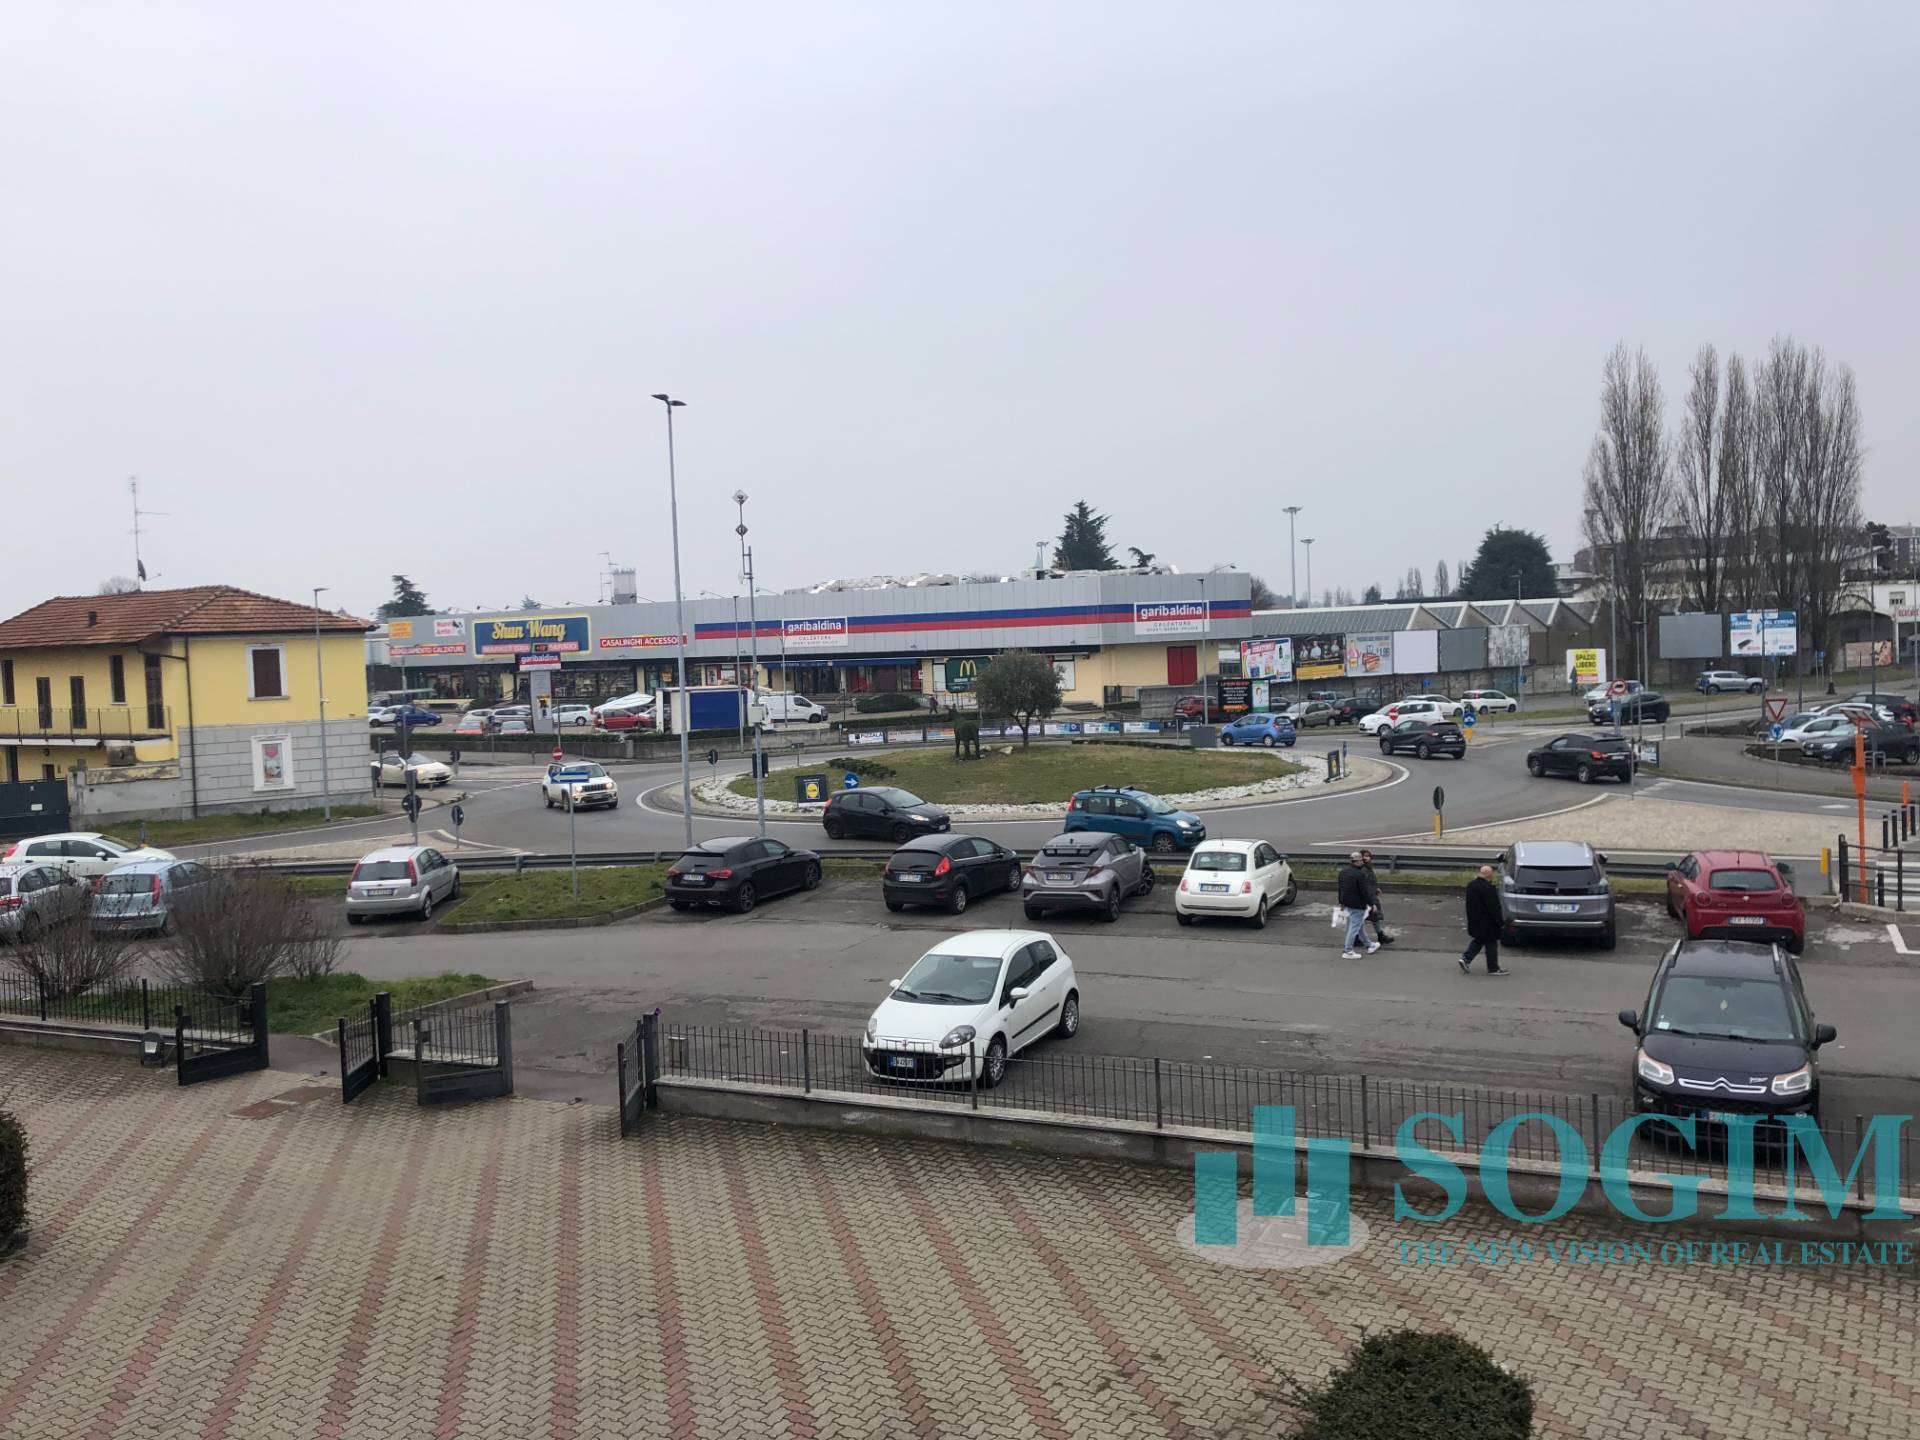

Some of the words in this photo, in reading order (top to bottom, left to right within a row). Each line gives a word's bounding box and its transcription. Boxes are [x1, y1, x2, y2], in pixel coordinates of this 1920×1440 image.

[1140, 603, 1203, 620] garibaldina
[492, 622, 525, 640] Shun
[527, 619, 567, 642] Wang
[787, 620, 842, 634] garibaldina
[601, 639, 643, 648] CASALINGHI
[644, 636, 683, 646] ACCESSO
[521, 653, 558, 665] garibaldina
